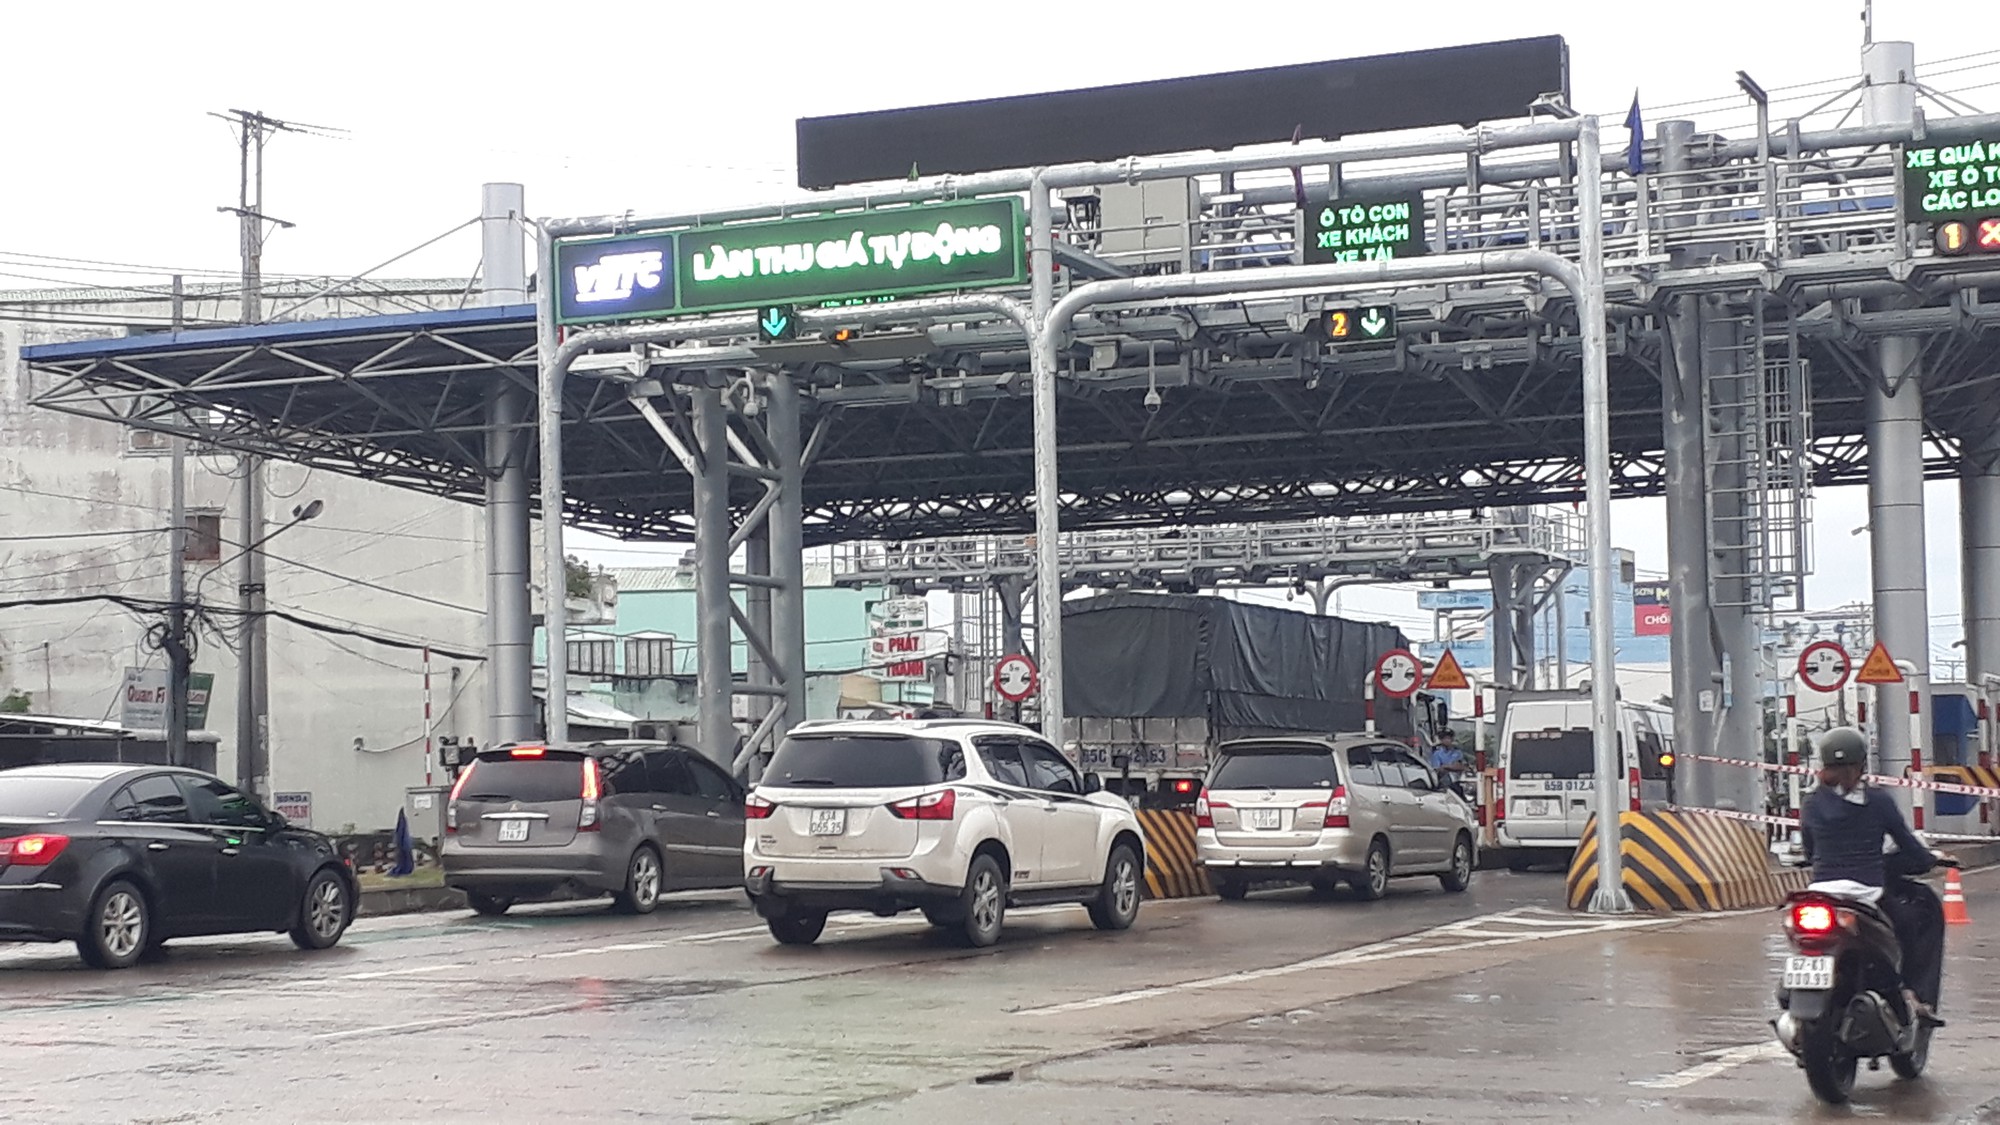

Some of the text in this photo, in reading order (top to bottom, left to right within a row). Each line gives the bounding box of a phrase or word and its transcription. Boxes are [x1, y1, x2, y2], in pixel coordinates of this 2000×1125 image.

[1906, 149, 1936, 168] XE
[1940, 140, 1986, 165] QUÁ
[1928, 165, 2000, 188] XE Ô T
[1922, 188, 1968, 211] CÁC
[1320, 202, 1409, 227] Ô TÔ CON
[1317, 223, 1409, 248] XE KHÁCH
[1945, 223, 1960, 249] 1
[693, 244, 753, 281] LÀN
[754, 238, 814, 275] THU
[816, 231, 868, 269] GIÁ
[868, 230, 911, 269] TỰ
[1334, 249, 1359, 265] XE
[1332, 313, 1347, 336] 2
